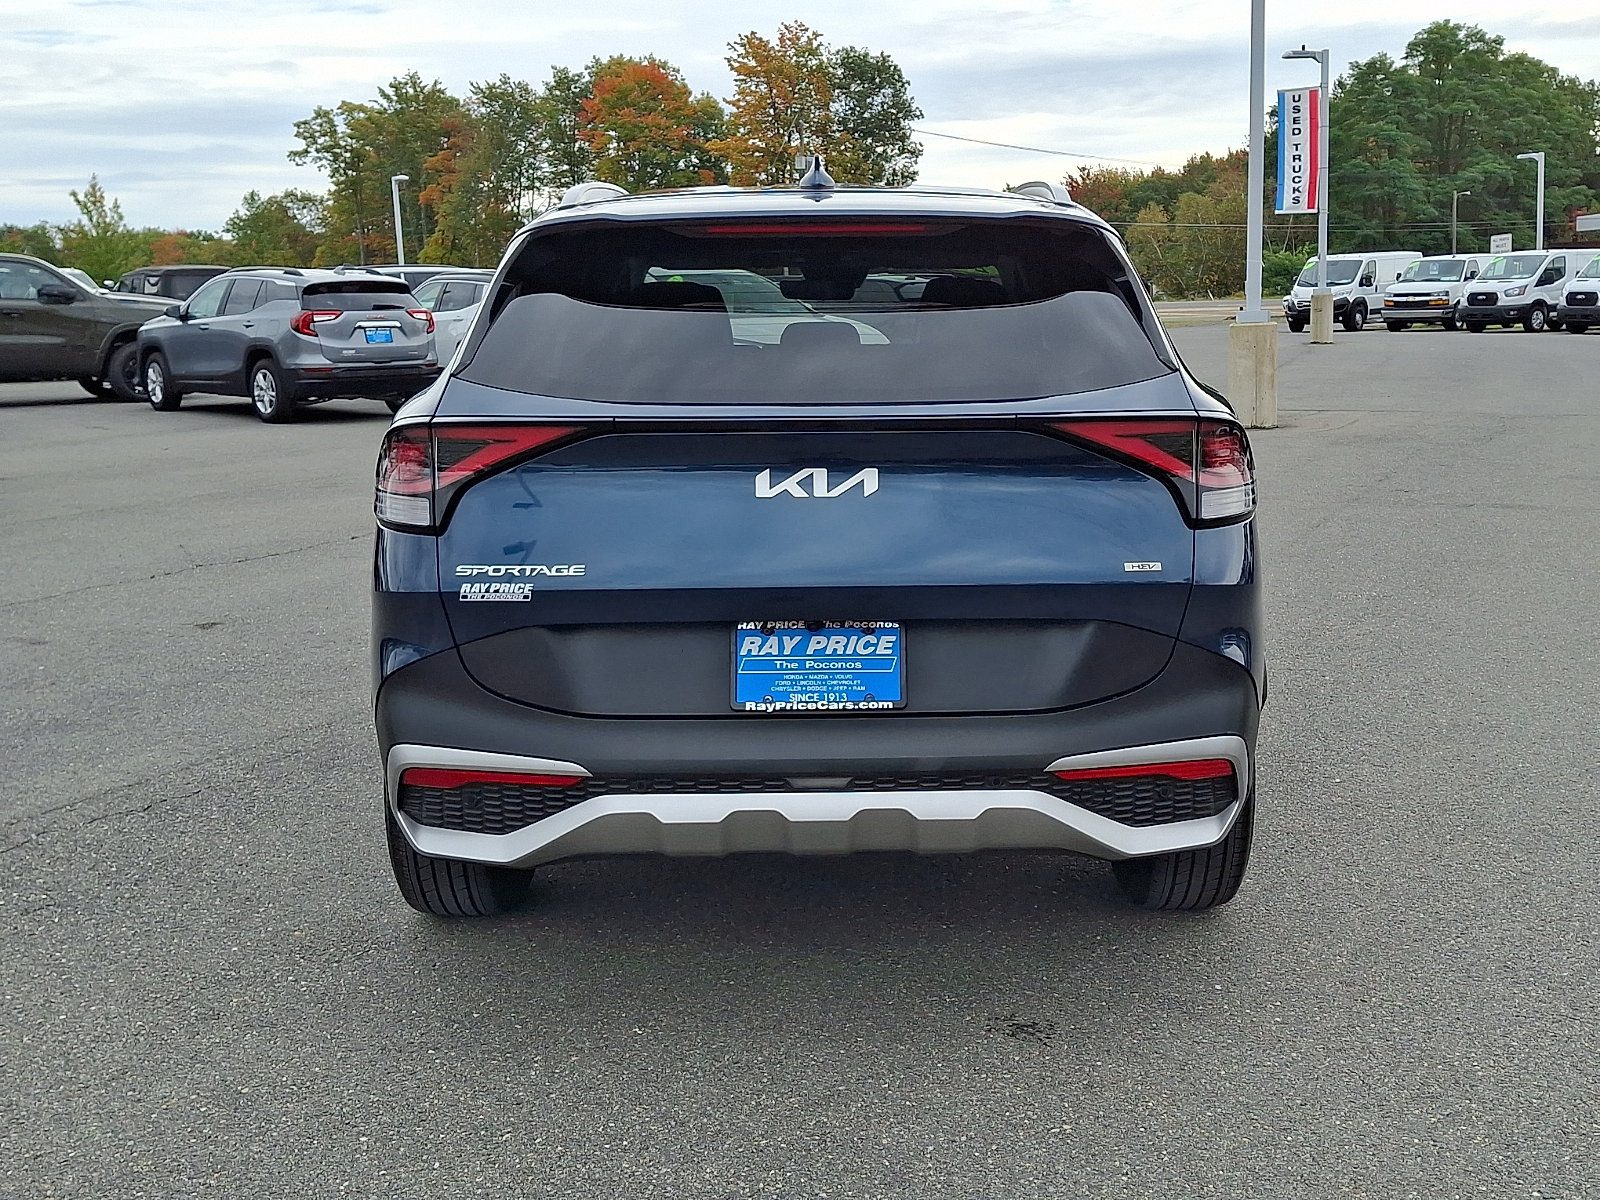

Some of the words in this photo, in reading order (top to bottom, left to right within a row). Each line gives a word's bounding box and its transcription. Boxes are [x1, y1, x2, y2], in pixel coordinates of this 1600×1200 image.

[1292, 94, 1302, 136] USED
[1292, 143, 1303, 205] TRUCKS
[755, 467, 879, 498] KIA
[455, 565, 586, 577] SPORTAGE
[460, 583, 490, 594] RAY
[490, 583, 534, 594] PRICE
[766, 620, 806, 629] PRICE
[739, 635, 803, 656] RAY
[805, 635, 897, 656] PRICE
[774, 660, 799, 669] The
[805, 660, 863, 669] Poconos
[788, 693, 820, 702] SINCE
[823, 693, 848, 702] 1913
[745, 701, 894, 713] RayPriceCars.com
